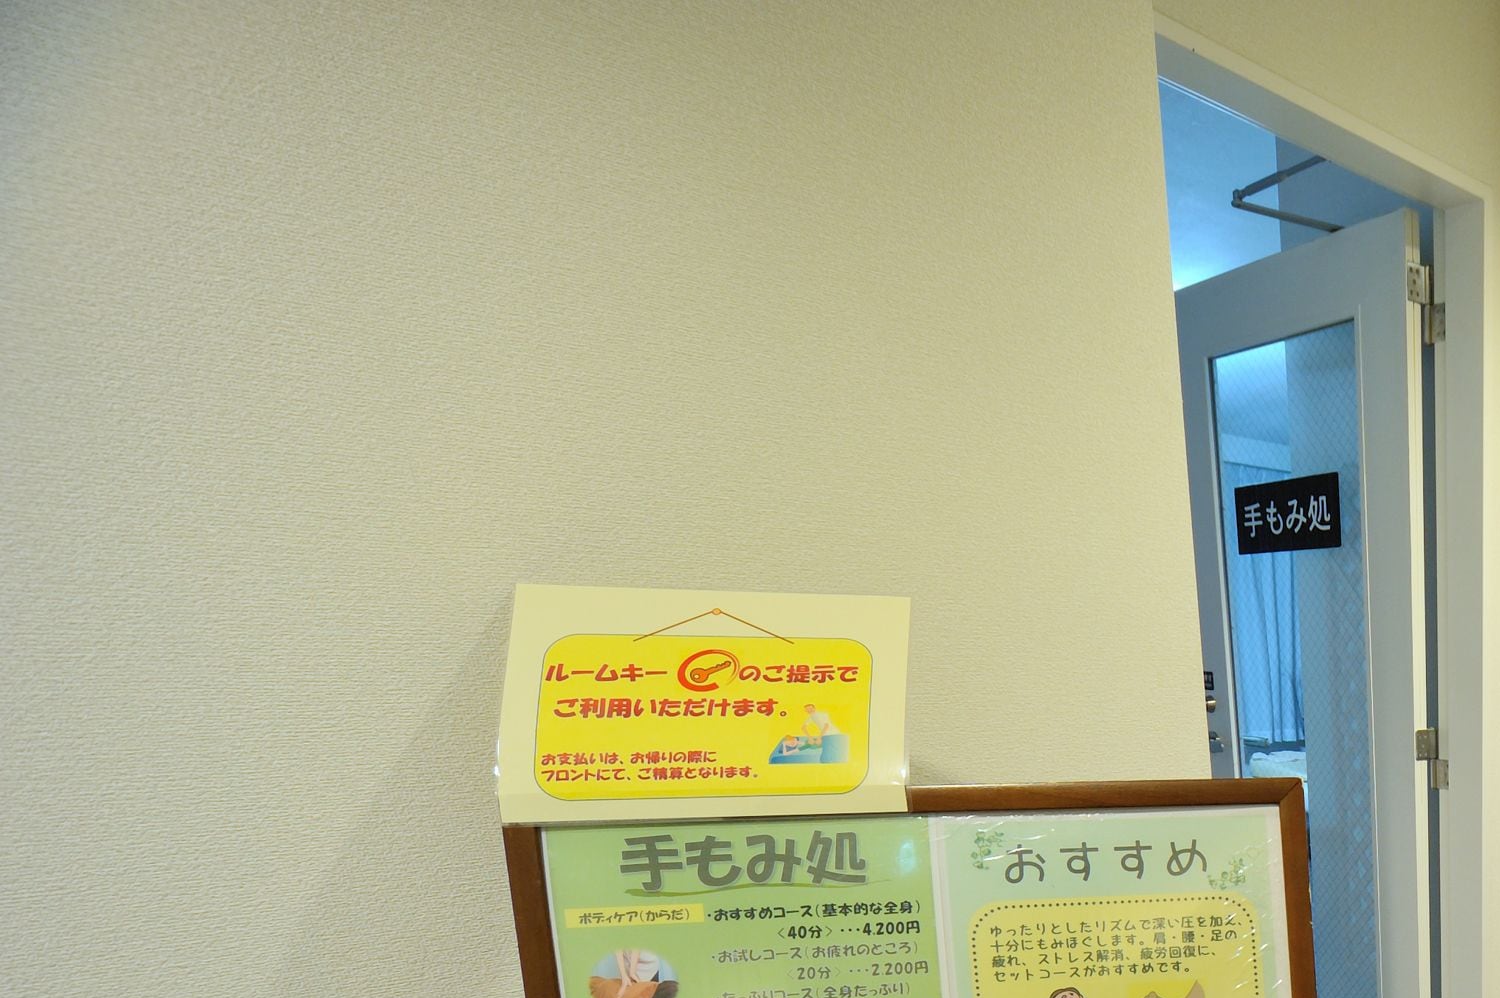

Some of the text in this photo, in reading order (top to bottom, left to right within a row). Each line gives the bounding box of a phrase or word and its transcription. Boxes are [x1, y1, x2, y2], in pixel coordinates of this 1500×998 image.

[1244, 495, 1331, 538] 手もみ処
[544, 662, 860, 684] ルームキー のご提示で
[553, 697, 789, 719] ご利用いただけます。
[541, 750, 718, 766] お支払いは、お帰りの際に
[541, 766, 759, 782] フロントにて、ご精算となります。
[619, 830, 868, 892] 手もみ処
[1004, 839, 1208, 884] おすすめ
[578, 908, 690, 925] ボディケア(からだ)
[994, 961, 1191, 983] セットコースがおすすめです。
